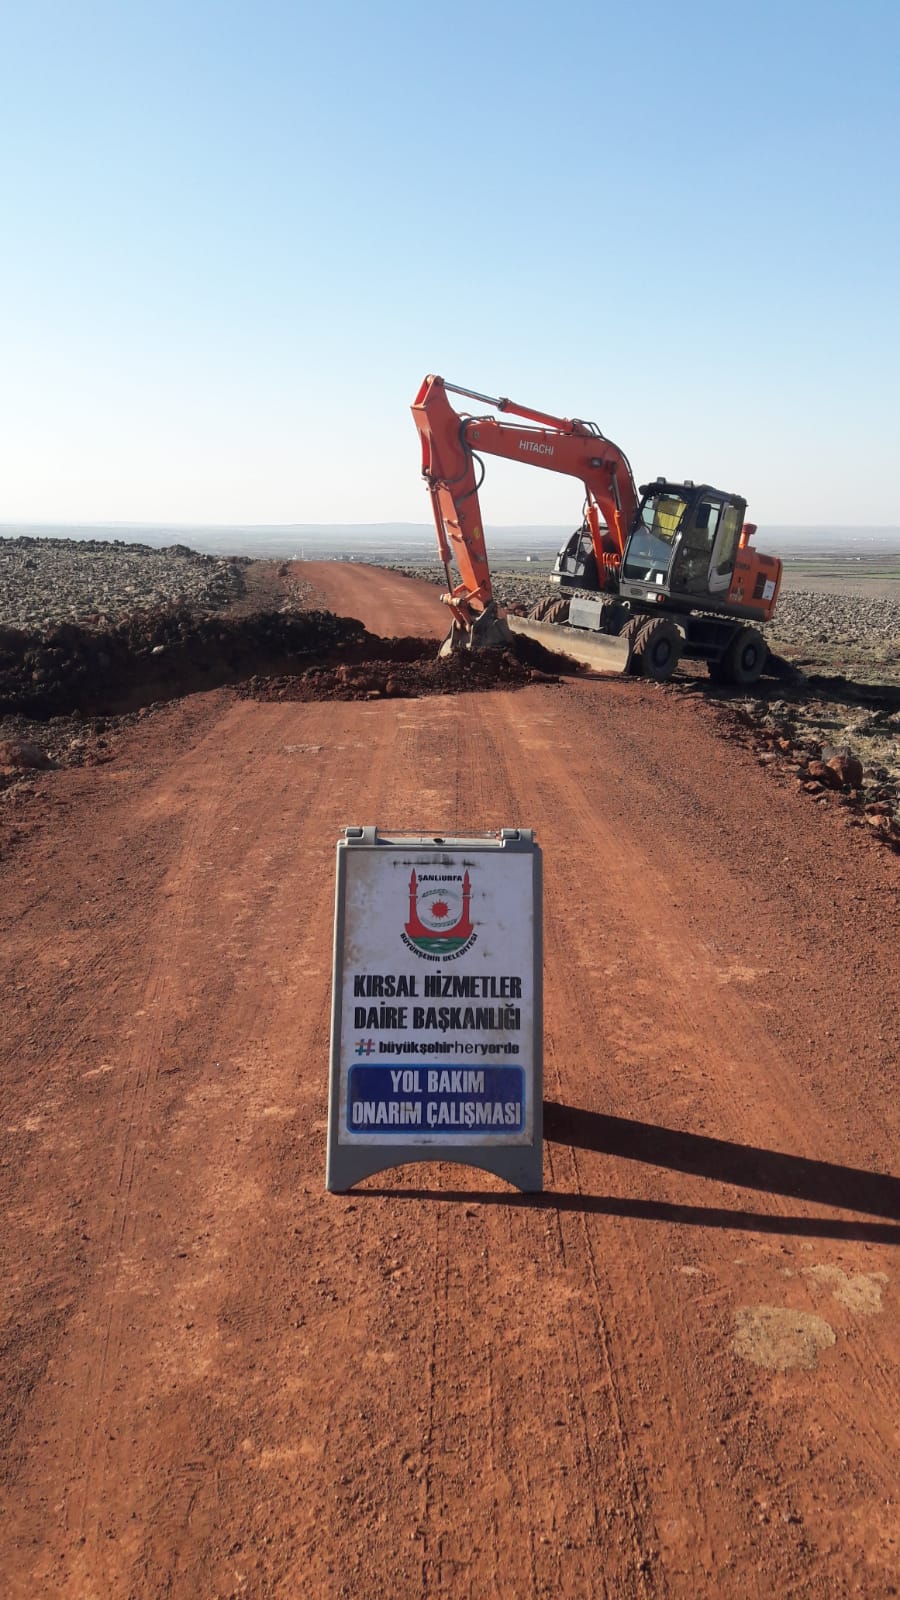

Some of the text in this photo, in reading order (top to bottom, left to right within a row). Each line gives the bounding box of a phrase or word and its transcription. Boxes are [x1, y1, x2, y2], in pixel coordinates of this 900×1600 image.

[519, 440, 555, 456] HITACHI
[354, 970, 522, 999] KIRSAL HİZMETLER
[354, 1001, 521, 1033] DAİRE BAŞKANLIĞI
[390, 1070, 485, 1093] YOL BAKIM
[352, 1101, 521, 1128] ONARIM ÇALIŞMASI
